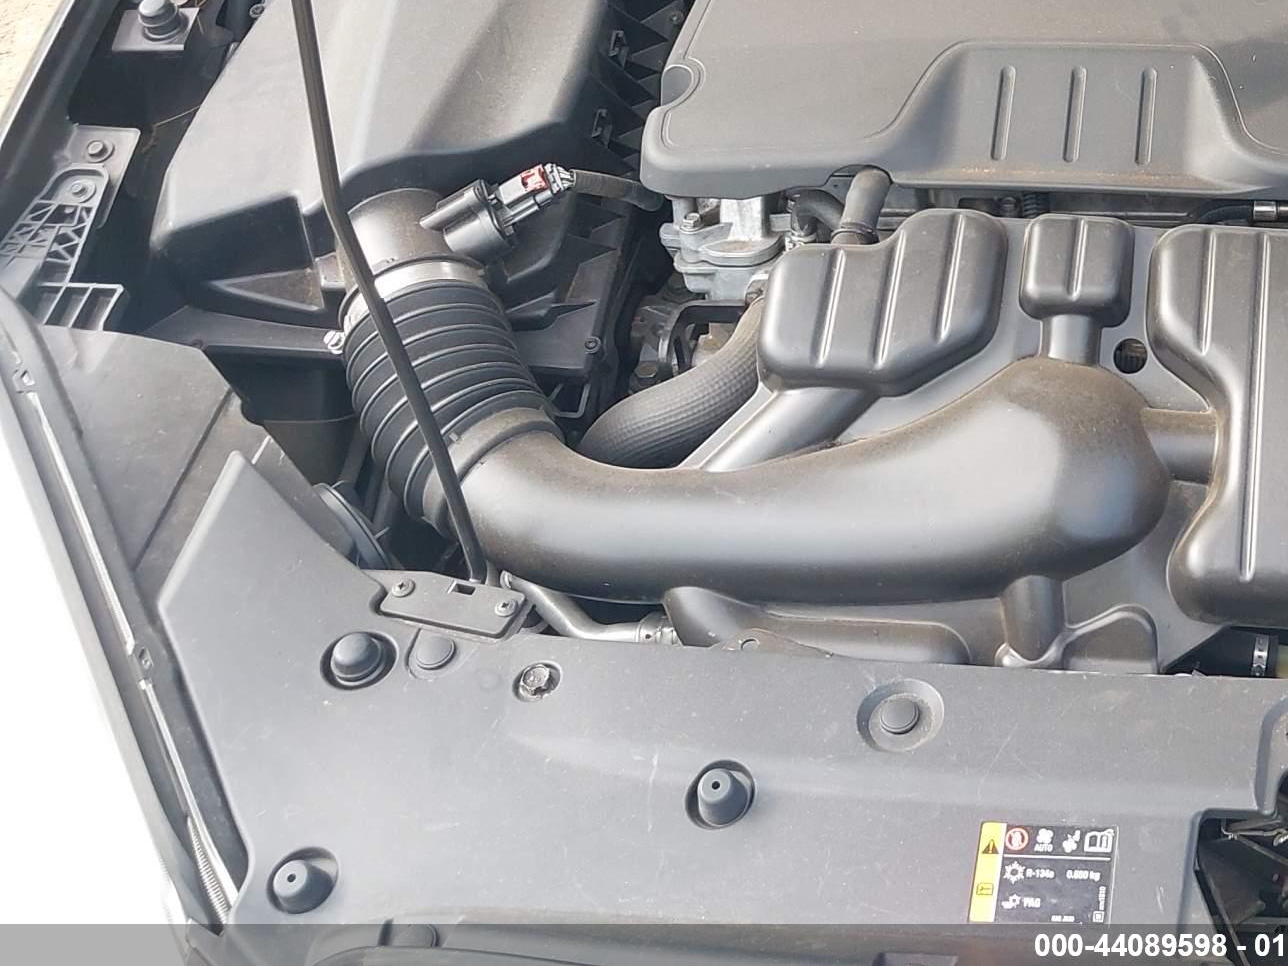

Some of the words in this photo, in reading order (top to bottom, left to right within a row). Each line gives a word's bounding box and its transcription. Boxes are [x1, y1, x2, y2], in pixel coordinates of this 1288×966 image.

[1033, 843, 1054, 853] AUTO
[1025, 867, 1055, 879] R-134a
[1022, 897, 1041, 908] PAG
